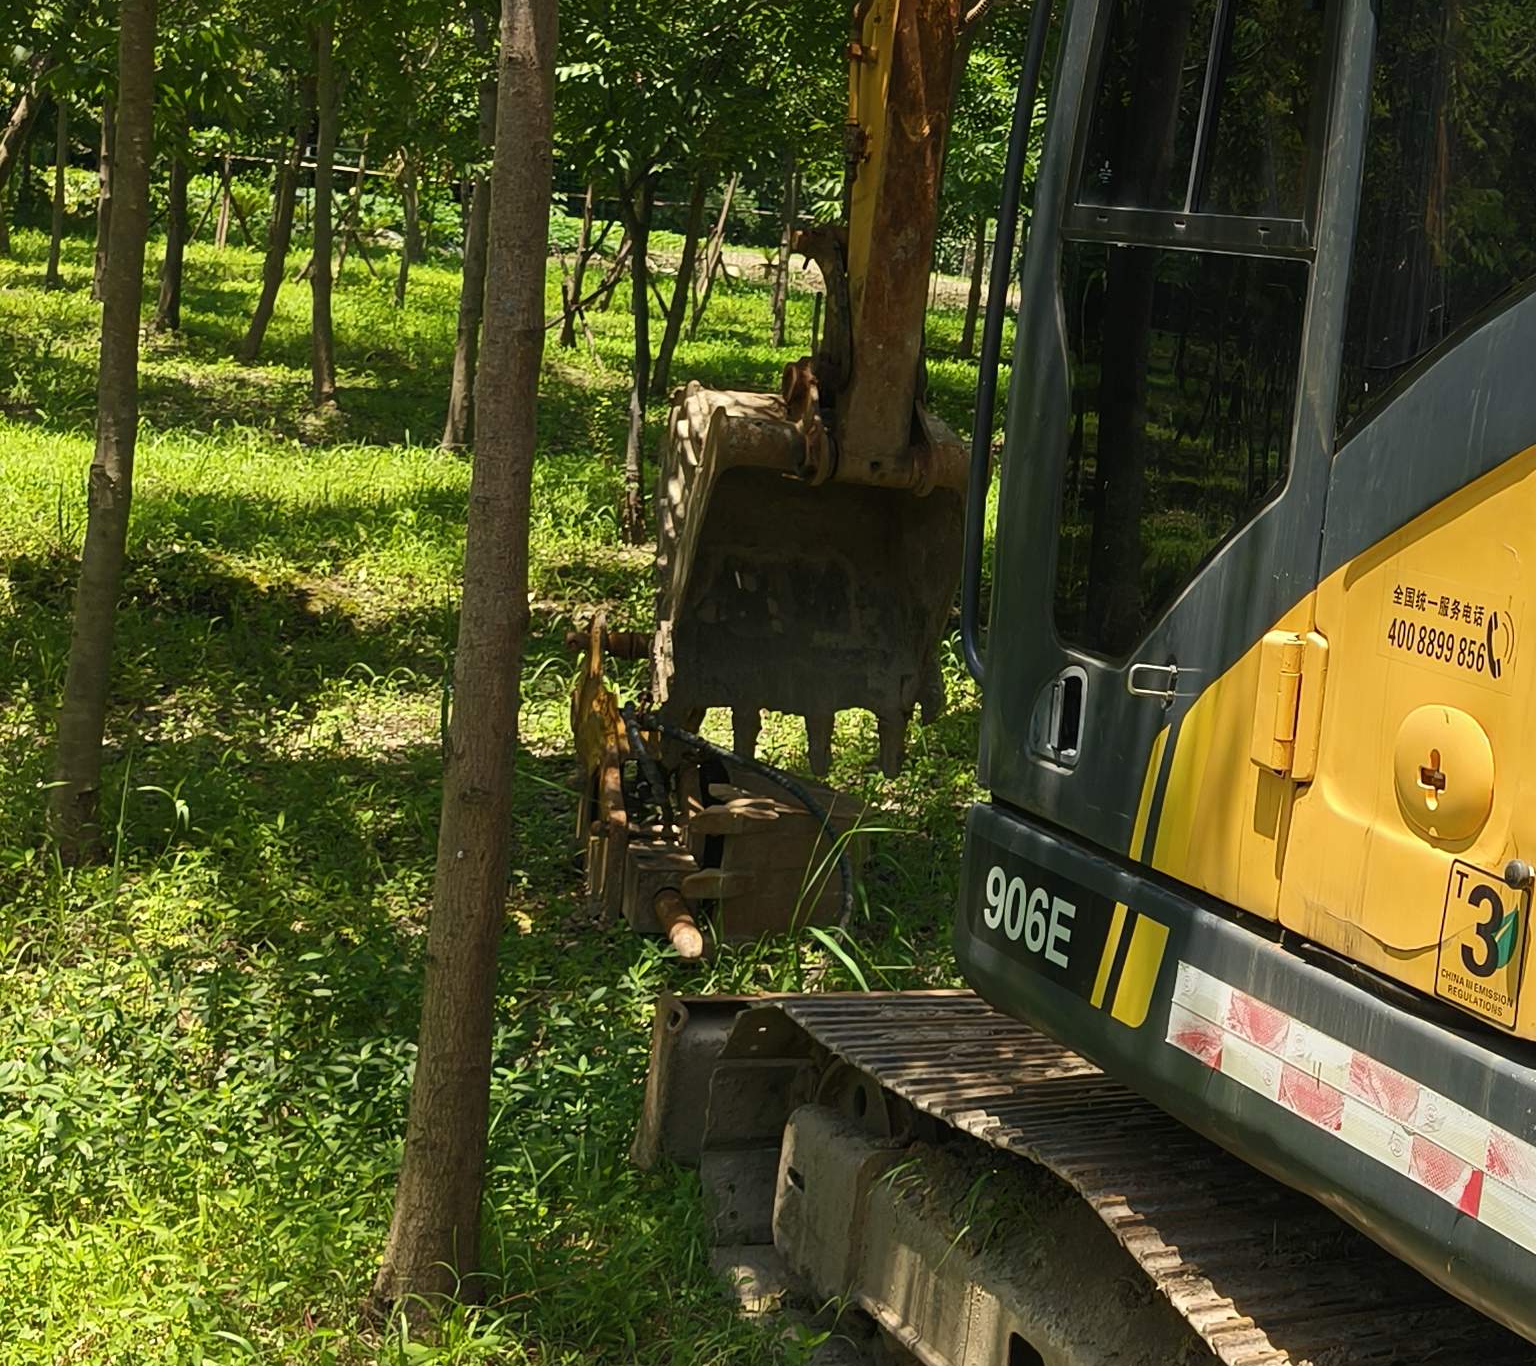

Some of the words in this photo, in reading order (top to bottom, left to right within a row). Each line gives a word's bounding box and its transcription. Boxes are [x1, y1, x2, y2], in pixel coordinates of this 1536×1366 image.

[1393, 584, 1485, 628] 全国统一服务电话
[1387, 618, 1415, 651] 400
[1417, 625, 1455, 663] 8899
[1457, 637, 1486, 673] 856
[1456, 870, 1469, 899] T
[984, 866, 1077, 970] 906E
[1461, 884, 1504, 978] 3
[1441, 968, 1465, 987] CHINA
[1474, 983, 1514, 1008] EMISSION
[1447, 984, 1503, 1017] REGULATIONS
